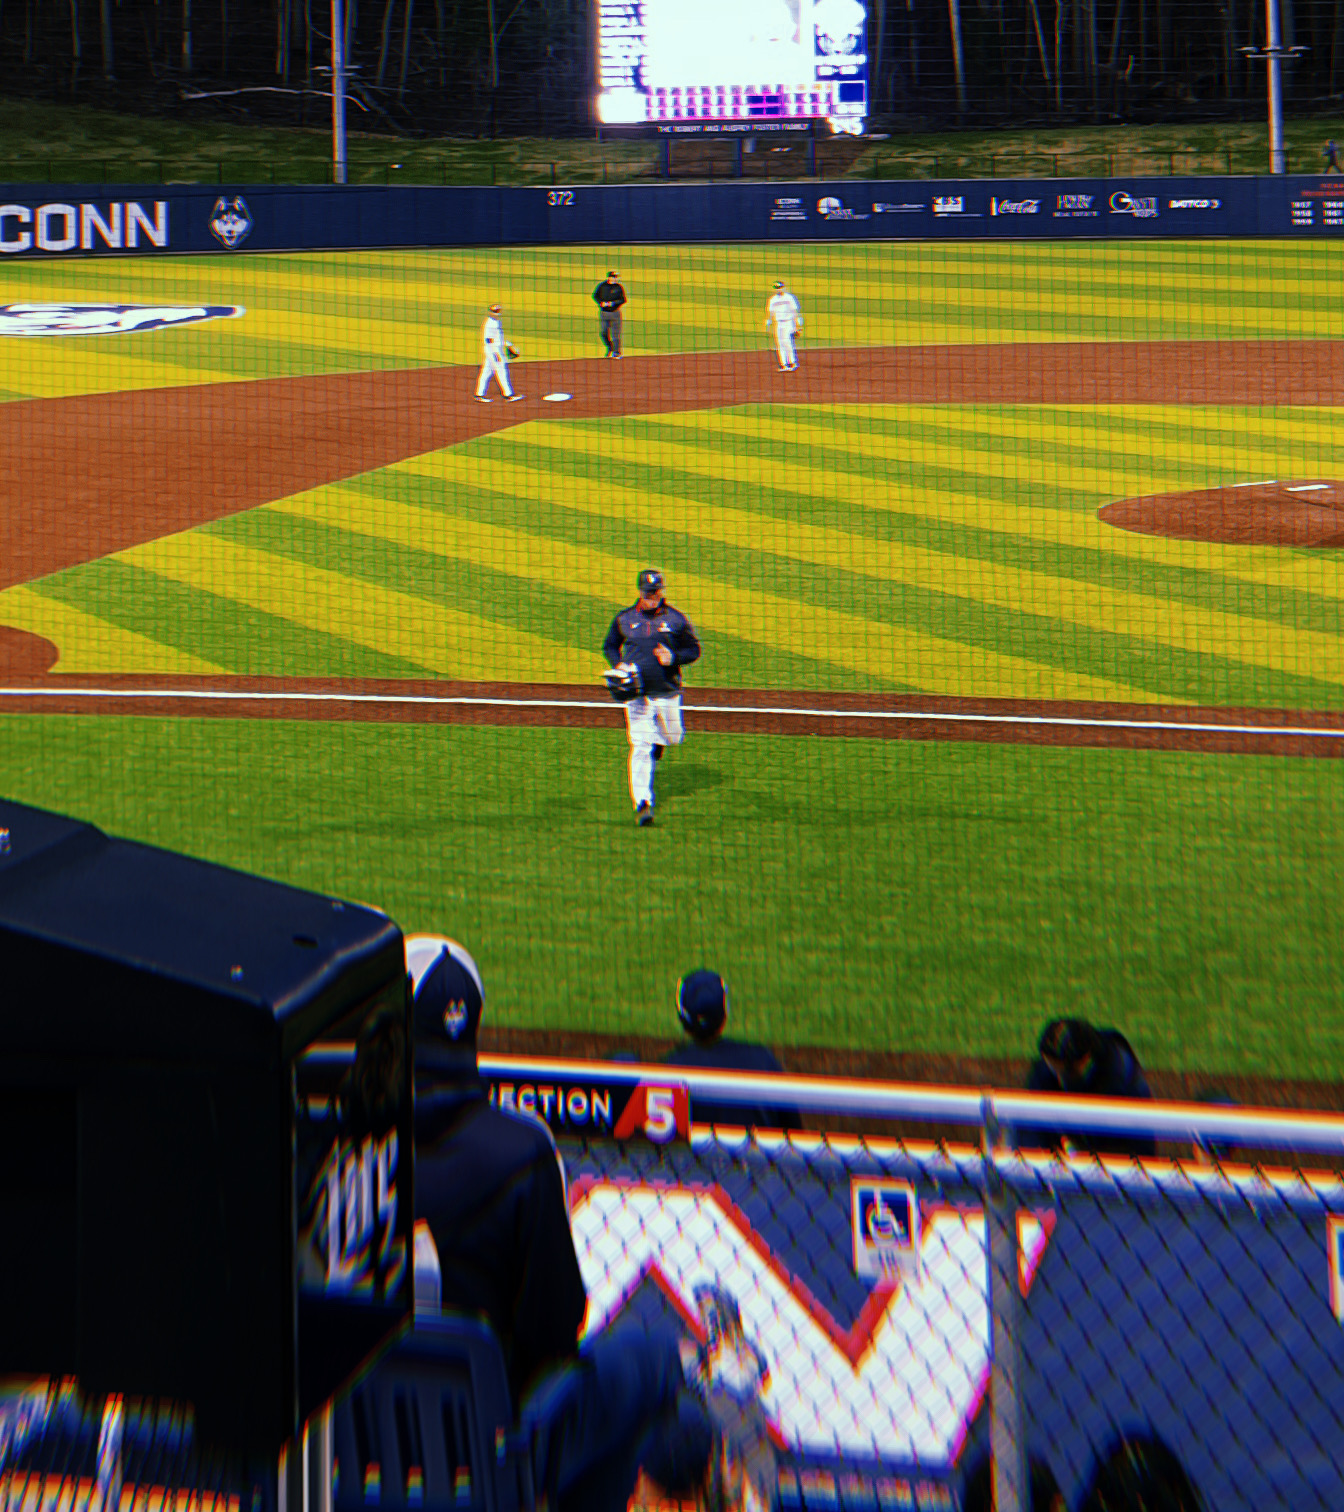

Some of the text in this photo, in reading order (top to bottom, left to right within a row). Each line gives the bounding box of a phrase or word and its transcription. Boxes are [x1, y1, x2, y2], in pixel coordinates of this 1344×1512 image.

[547, 190, 575, 207] 372
[488, 1082, 677, 1145] ECTION 5
